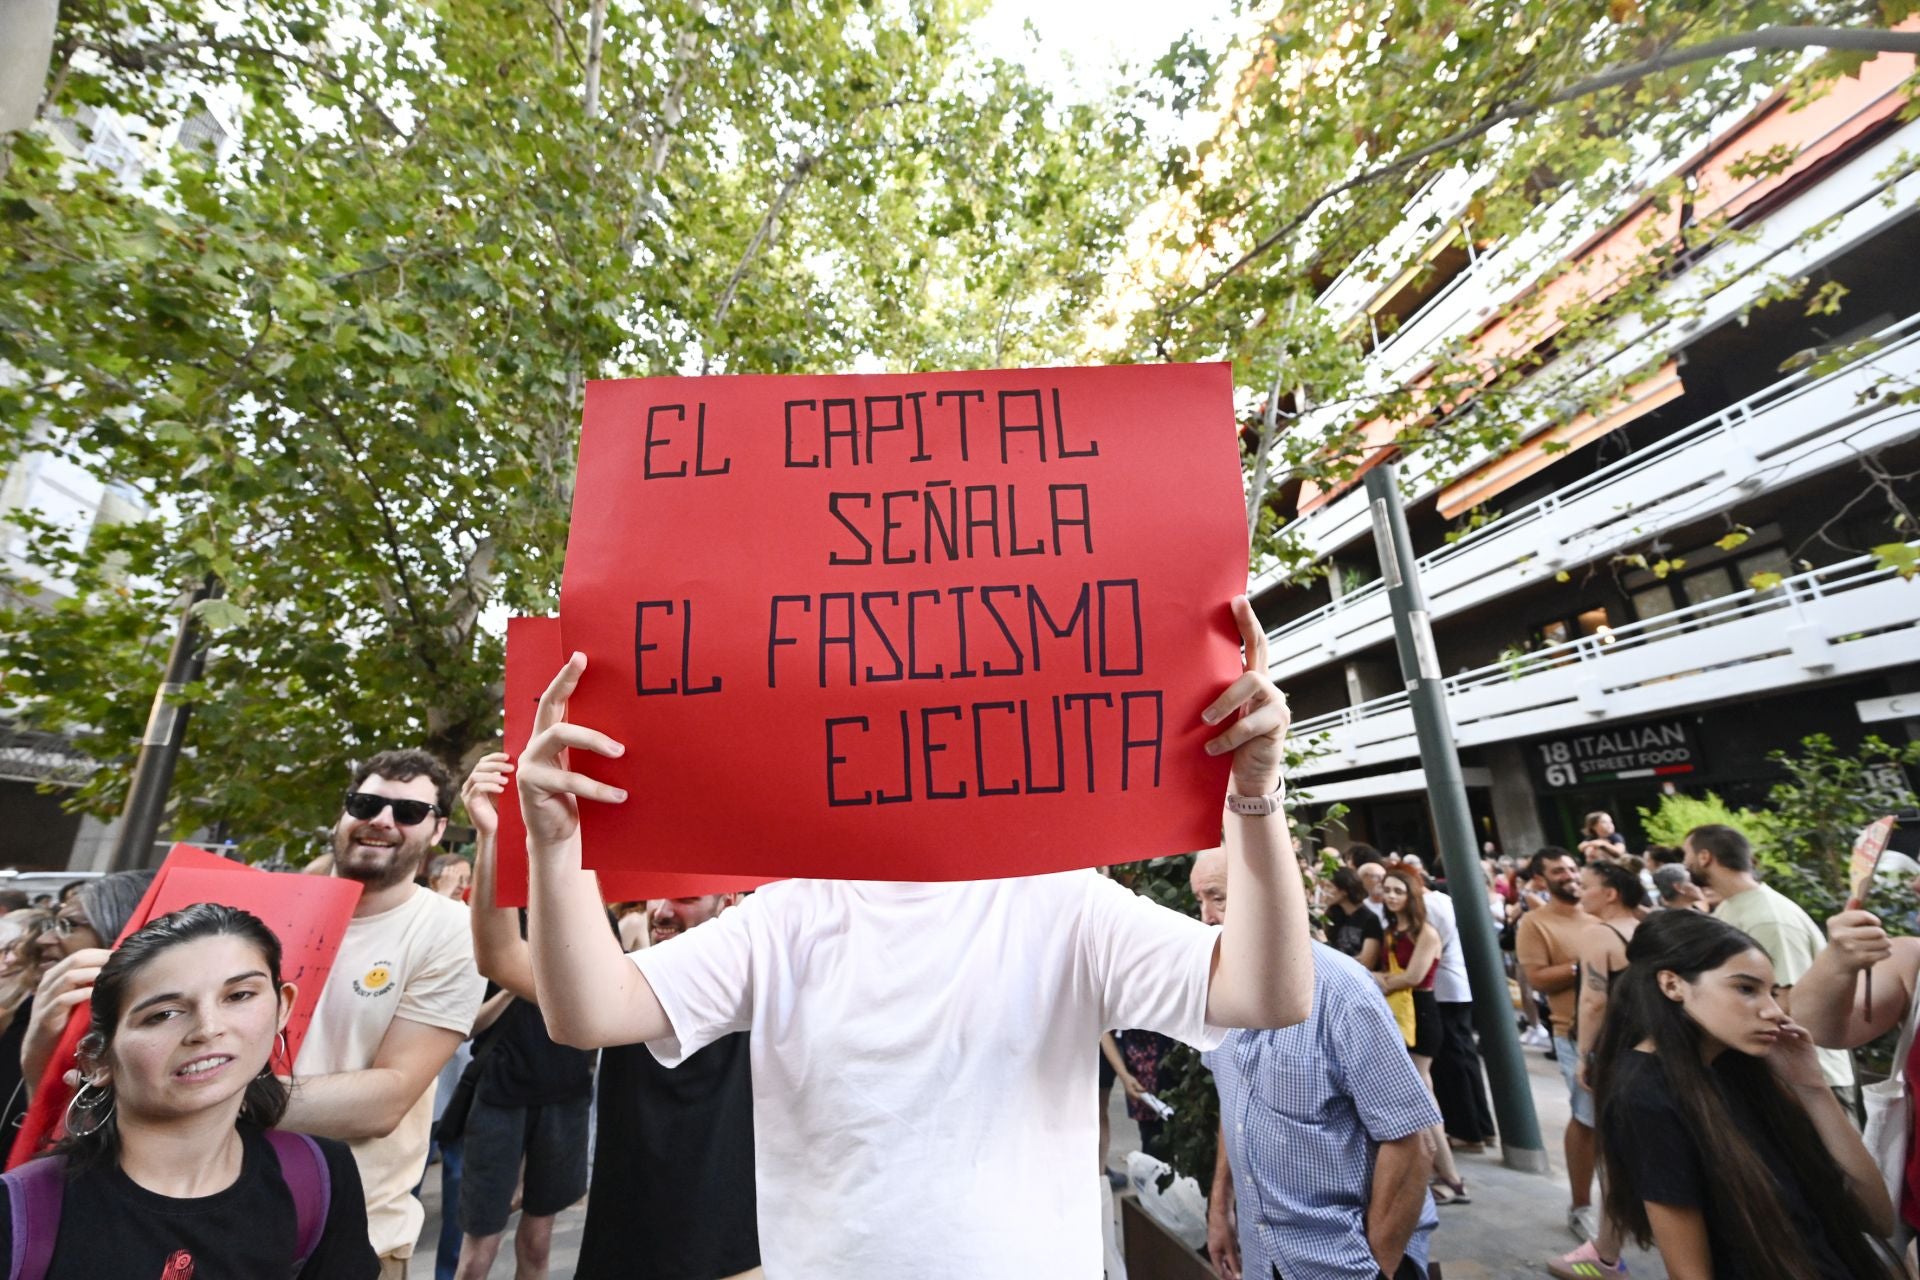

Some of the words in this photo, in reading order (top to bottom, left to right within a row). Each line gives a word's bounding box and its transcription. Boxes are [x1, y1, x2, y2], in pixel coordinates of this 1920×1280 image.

[645, 403, 730, 480] EL
[784, 388, 1099, 468] CAPITAL
[829, 480, 1093, 565] SEÑALA
[635, 600, 722, 696] EL
[768, 579, 1143, 688] FASCISMO
[825, 690, 1163, 807] EJECUTA
[1539, 742, 1571, 764] 18
[1573, 722, 1686, 758] ITALIAN
[1545, 762, 1578, 787] 61
[1579, 754, 1634, 773] STREET
[1637, 747, 1691, 766] FOOD
